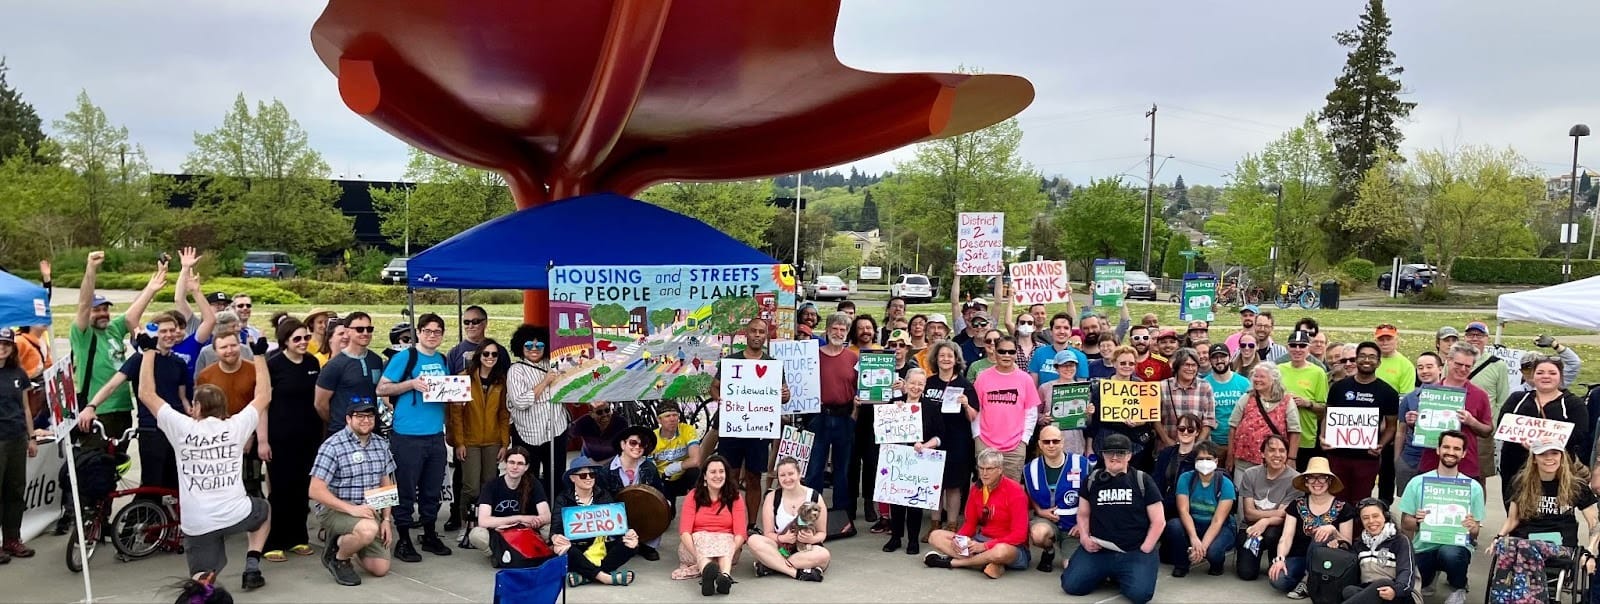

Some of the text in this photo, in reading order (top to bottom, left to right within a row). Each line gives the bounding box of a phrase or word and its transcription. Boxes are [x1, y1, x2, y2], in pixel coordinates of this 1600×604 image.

[962, 214, 998, 226] District
[974, 226, 985, 239] 2
[960, 239, 1002, 249] Deserves
[965, 249, 988, 261] Safe
[555, 268, 759, 284] HOUSING and STREETS
[1012, 262, 1062, 277] OUR KIDS
[1014, 277, 1061, 290] THANK
[552, 282, 759, 303] for PEOPLE and PLANET
[1026, 290, 1052, 303] YOU
[775, 341, 810, 357] WHAT
[786, 358, 814, 372] TURE
[862, 355, 877, 363] Sign
[731, 365, 744, 379] I
[788, 373, 802, 384] DO
[727, 384, 779, 396] Sidewalks
[789, 385, 804, 398] OU
[1053, 388, 1070, 397] Sign
[1102, 382, 1158, 397] PLACES
[1213, 390, 1242, 399] GALIZE
[1422, 391, 1441, 401] Sign
[726, 401, 775, 413] Bike Lanes
[1122, 398, 1140, 406] FOR
[741, 413, 751, 422] &
[1102, 406, 1158, 420] PEOPLE
[1328, 412, 1380, 427] SIDEWALKS
[726, 421, 774, 433] Bus Lanes!
[1515, 417, 1548, 428] CARE
[186, 431, 229, 447] MAKE
[1336, 427, 1377, 446] NOW
[1498, 425, 1567, 444] EACH OTHER
[181, 444, 239, 461] SEATTLE
[780, 440, 811, 460] DEFUND
[183, 461, 239, 475] LIVABLE
[891, 465, 929, 485] Deserve
[24, 474, 55, 511] ttle
[881, 482, 888, 495] A
[1424, 486, 1445, 497] Sign
[1097, 489, 1133, 502] SHARE
[574, 510, 610, 520] VISION
